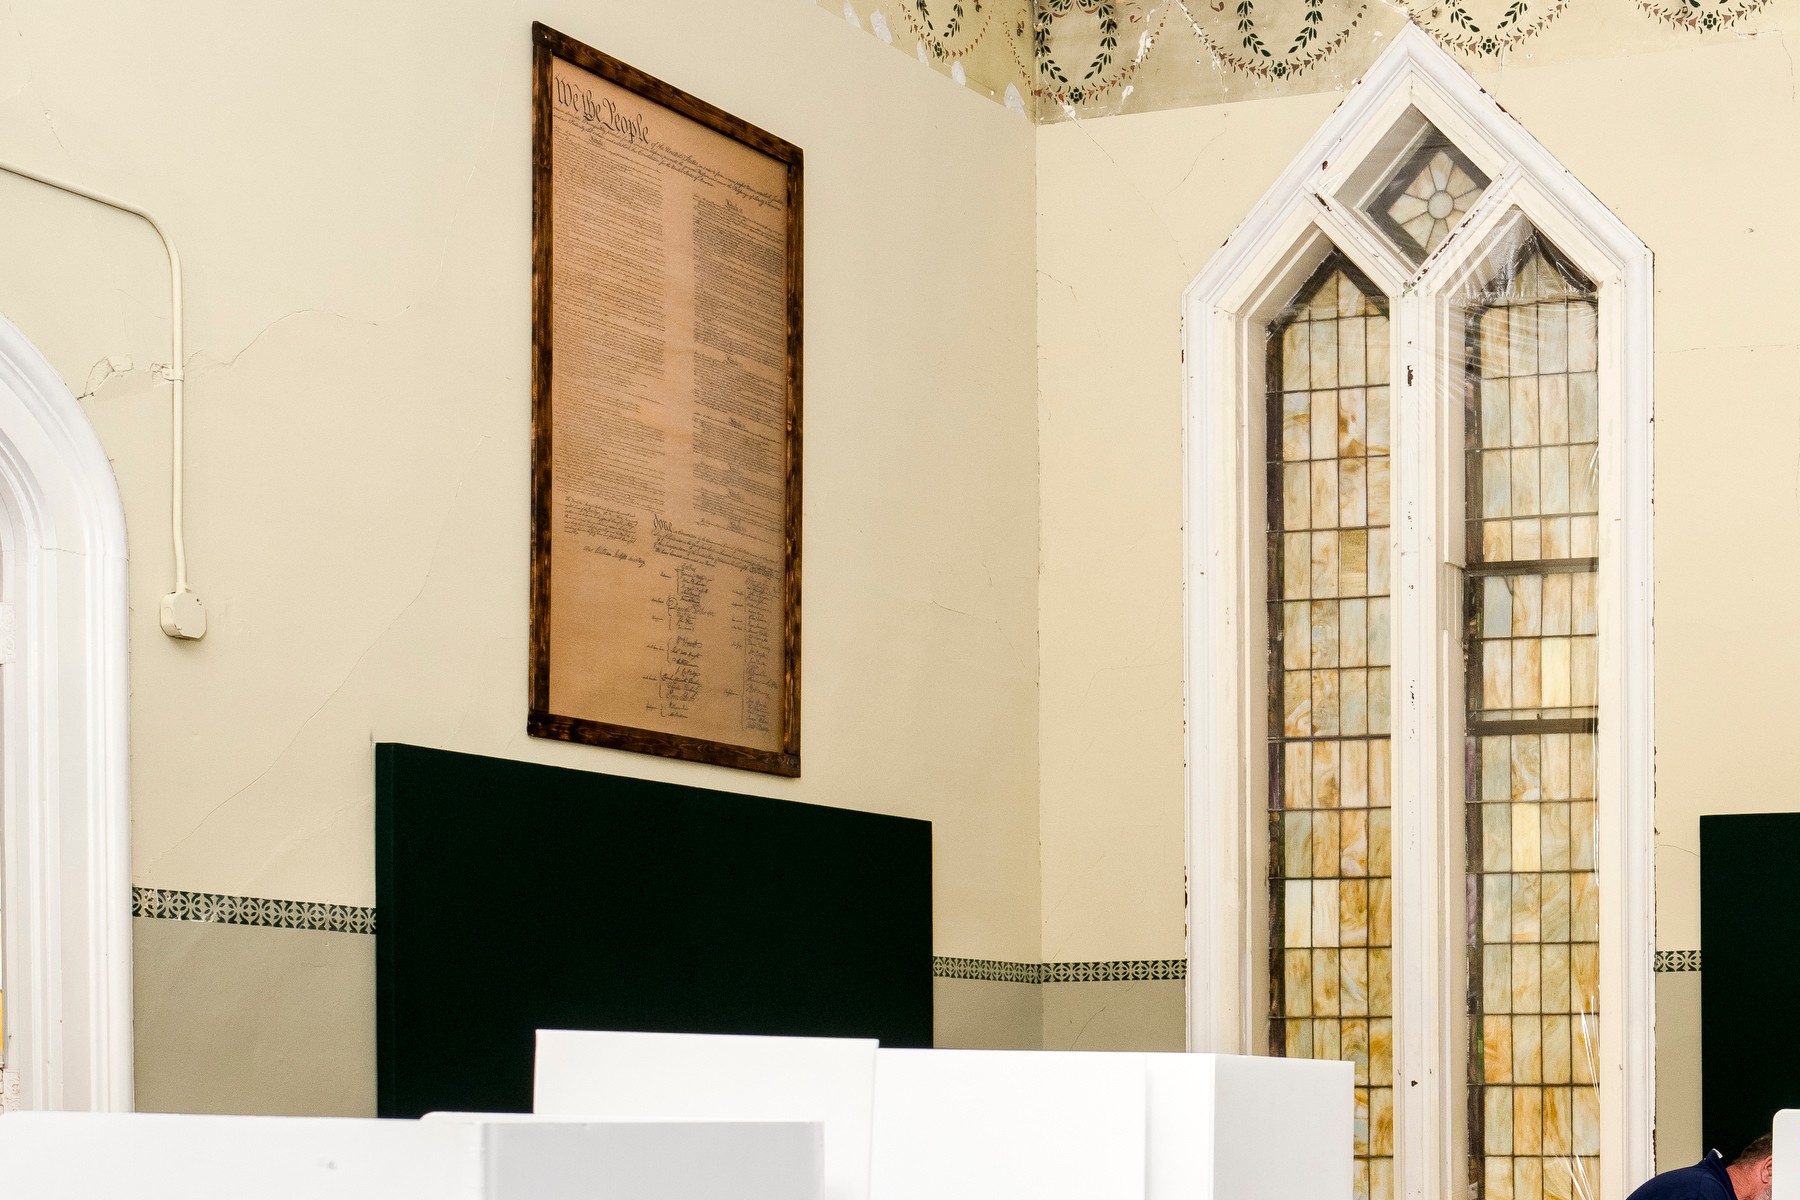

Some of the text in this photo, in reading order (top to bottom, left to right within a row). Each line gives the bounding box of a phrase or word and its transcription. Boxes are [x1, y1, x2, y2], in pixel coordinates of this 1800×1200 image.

[554, 74, 579, 112] We
[574, 84, 601, 122] the
[602, 97, 649, 145] People
